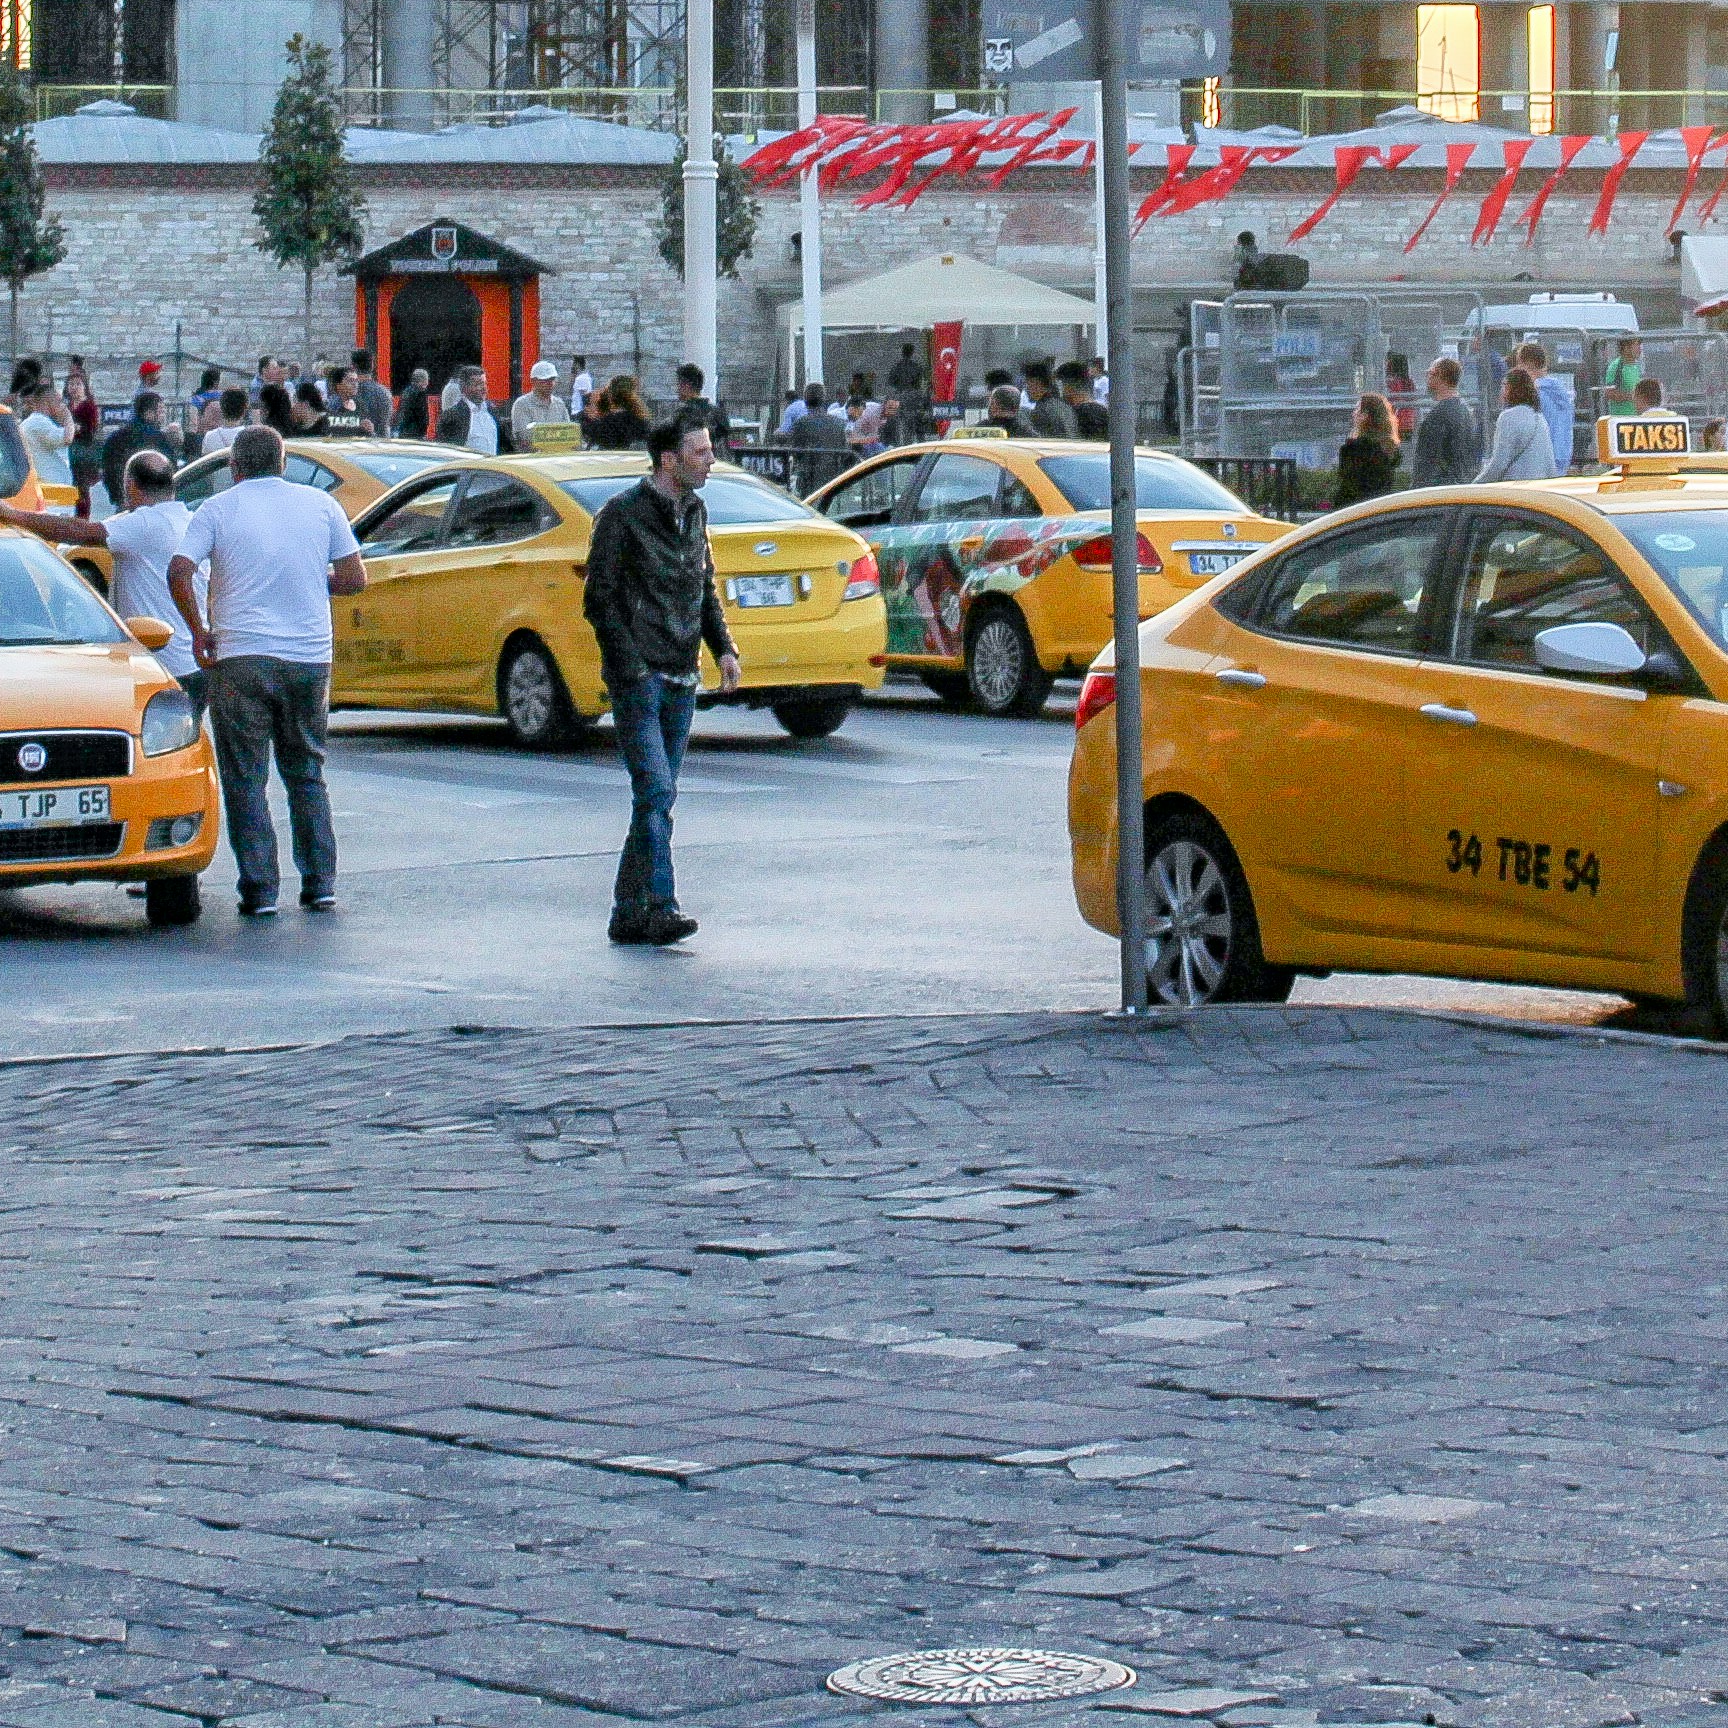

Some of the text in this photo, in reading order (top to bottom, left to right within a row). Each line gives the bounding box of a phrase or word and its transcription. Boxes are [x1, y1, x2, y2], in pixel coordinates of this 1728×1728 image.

[18, 793, 57, 819] TJP
[78, 790, 104, 815] 65
[1446, 828, 1601, 896] 34 TBE 54
